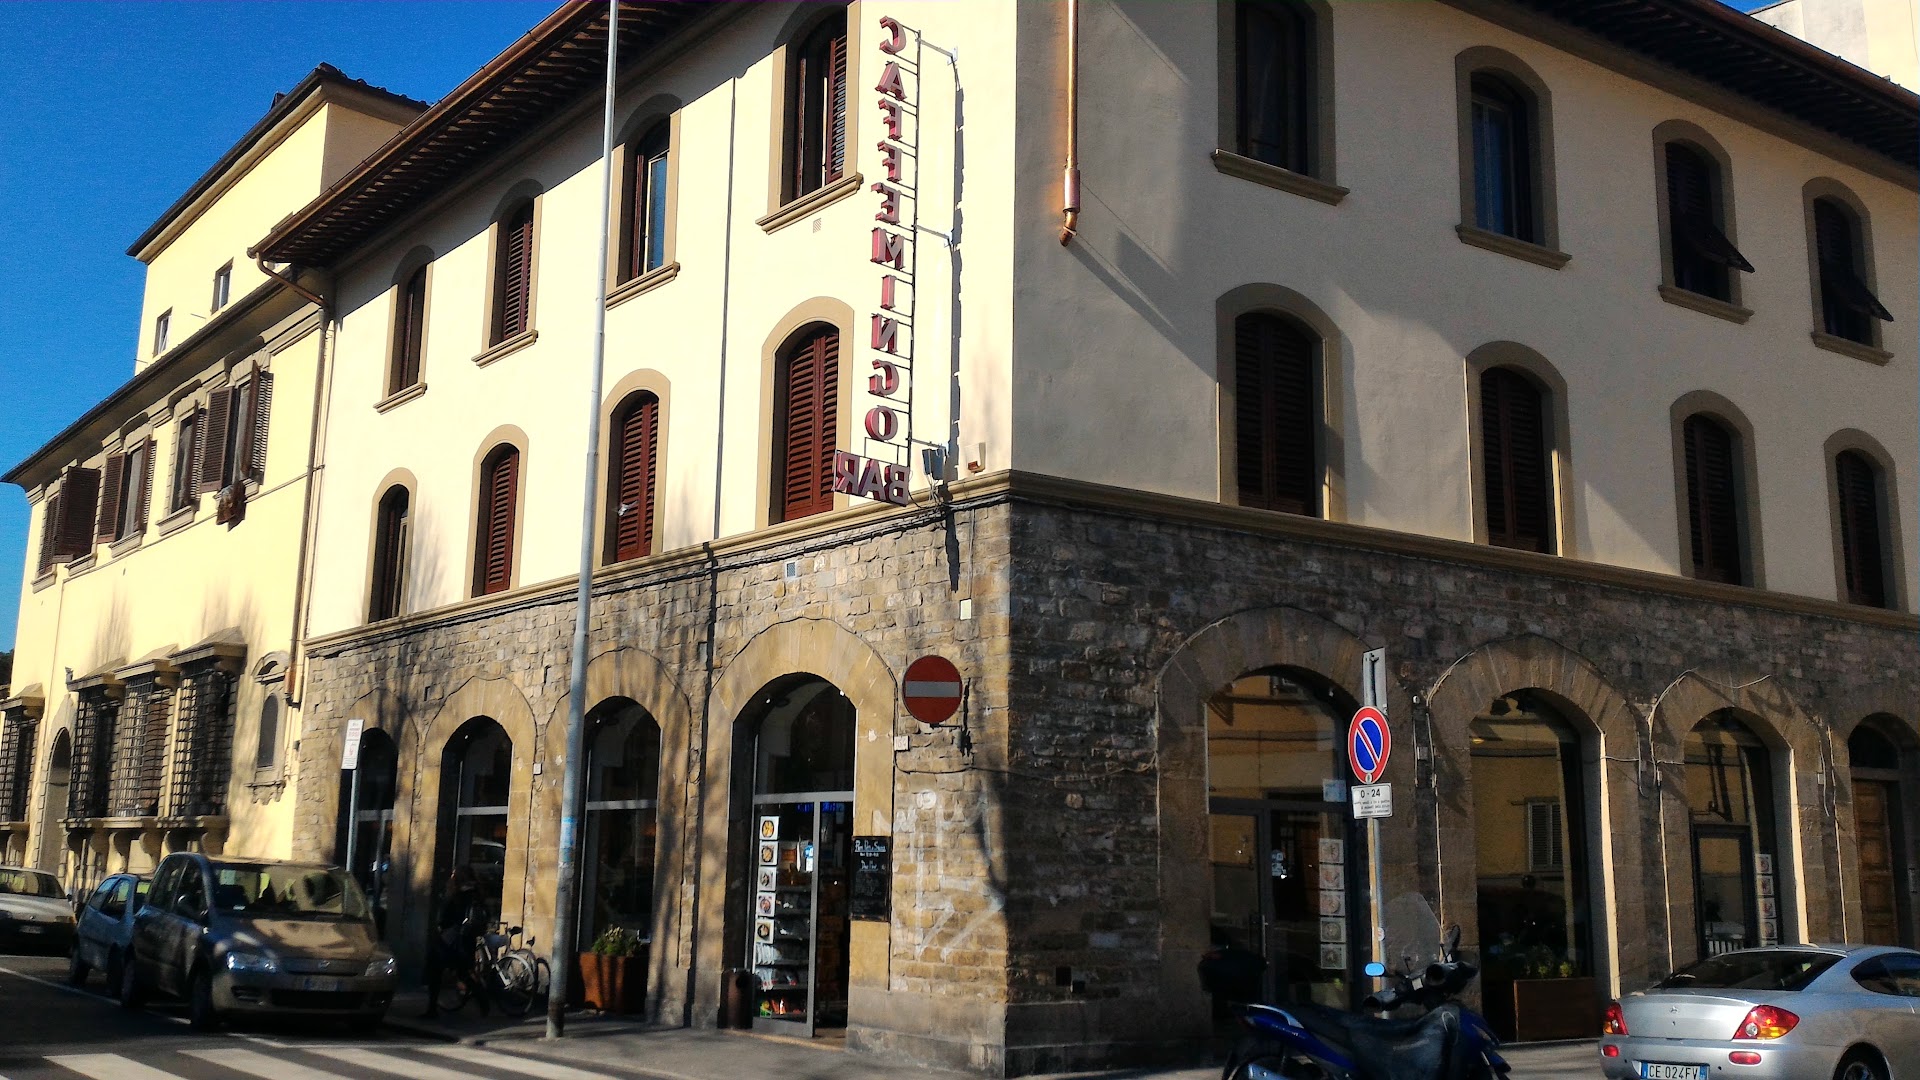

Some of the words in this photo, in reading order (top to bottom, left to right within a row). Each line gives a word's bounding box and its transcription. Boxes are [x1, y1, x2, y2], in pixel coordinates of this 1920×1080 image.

[1371, 788, 1380, 797] 24
[1649, 1065, 1661, 1078] CE
[1665, 1066, 1698, 1080] 024FV
